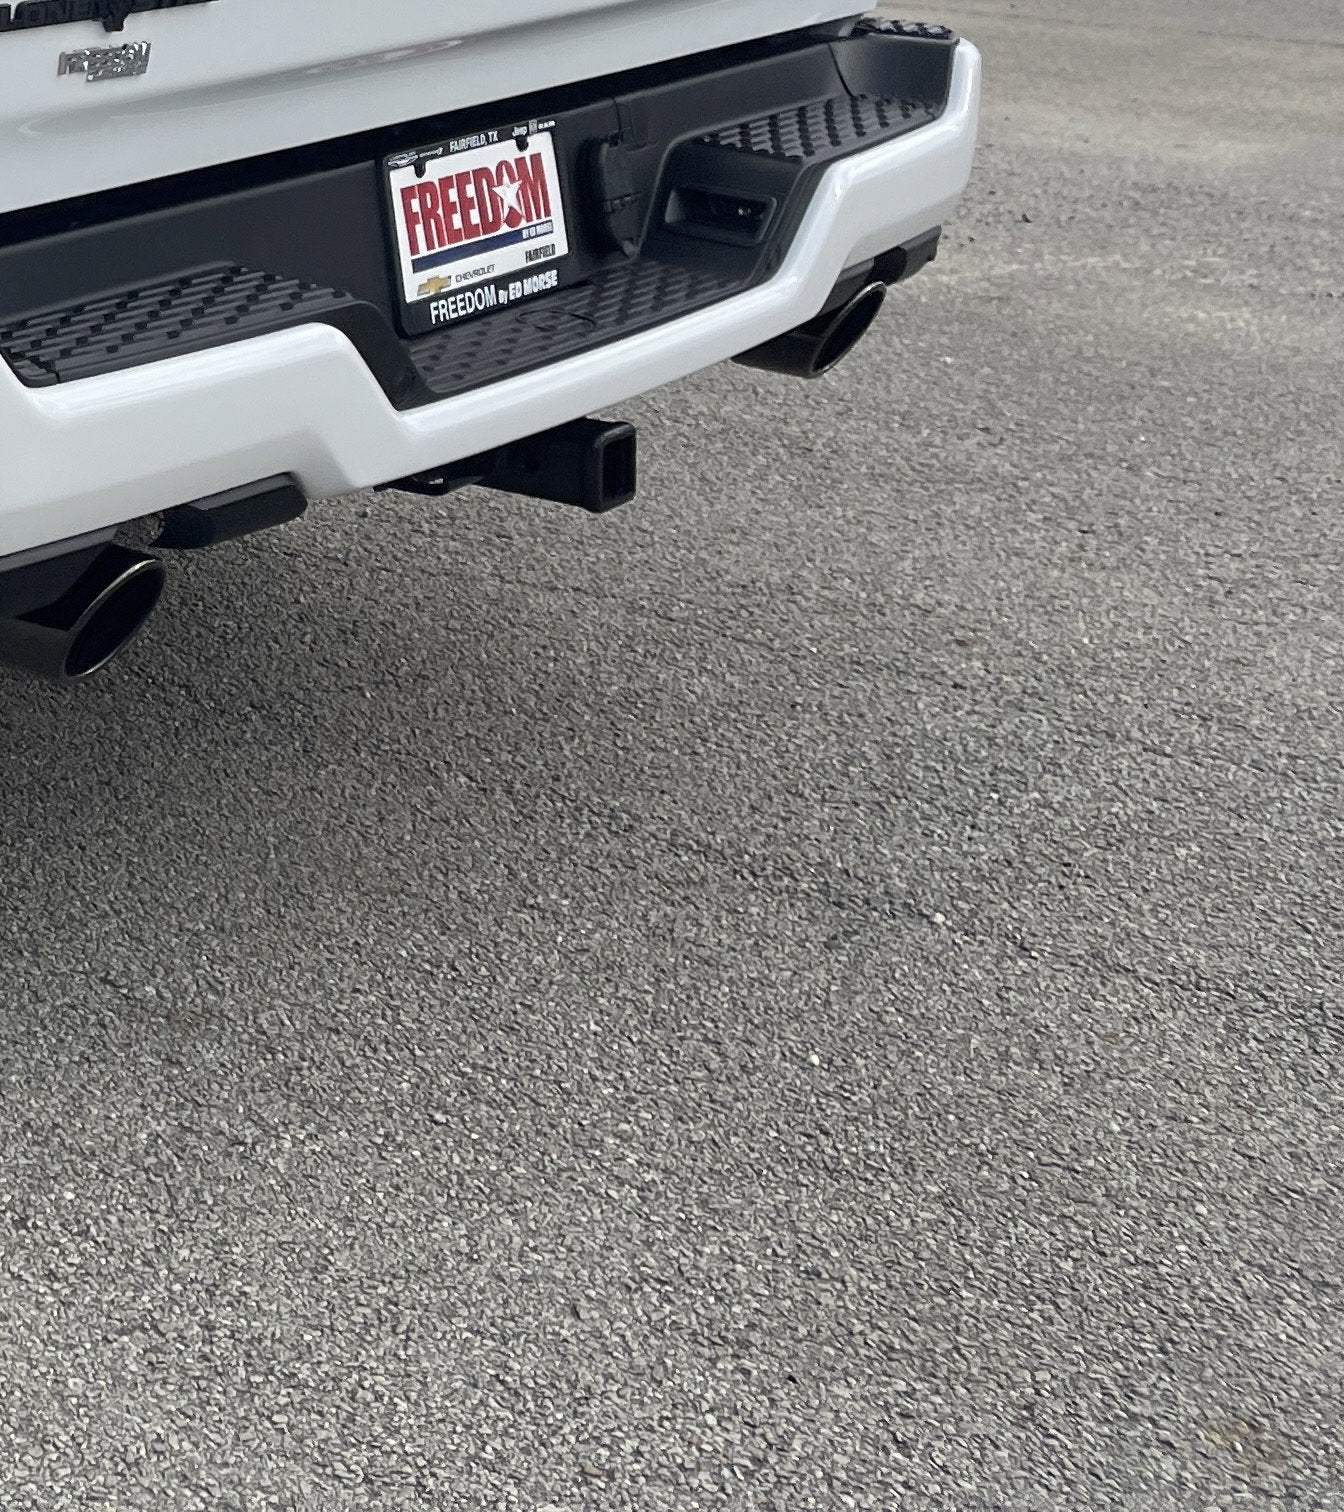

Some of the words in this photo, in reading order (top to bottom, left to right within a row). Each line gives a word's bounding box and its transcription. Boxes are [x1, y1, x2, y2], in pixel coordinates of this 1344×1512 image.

[449, 133, 488, 154] FAIRFIELD,
[487, 130, 499, 144] TX
[400, 153, 551, 256] FREEDOM
[525, 243, 556, 264] FAIRFIELD
[455, 264, 496, 283] CHEVROLET
[429, 284, 498, 325] FREEDOM
[508, 282, 523, 301] ED
[523, 269, 559, 296] MORSE
